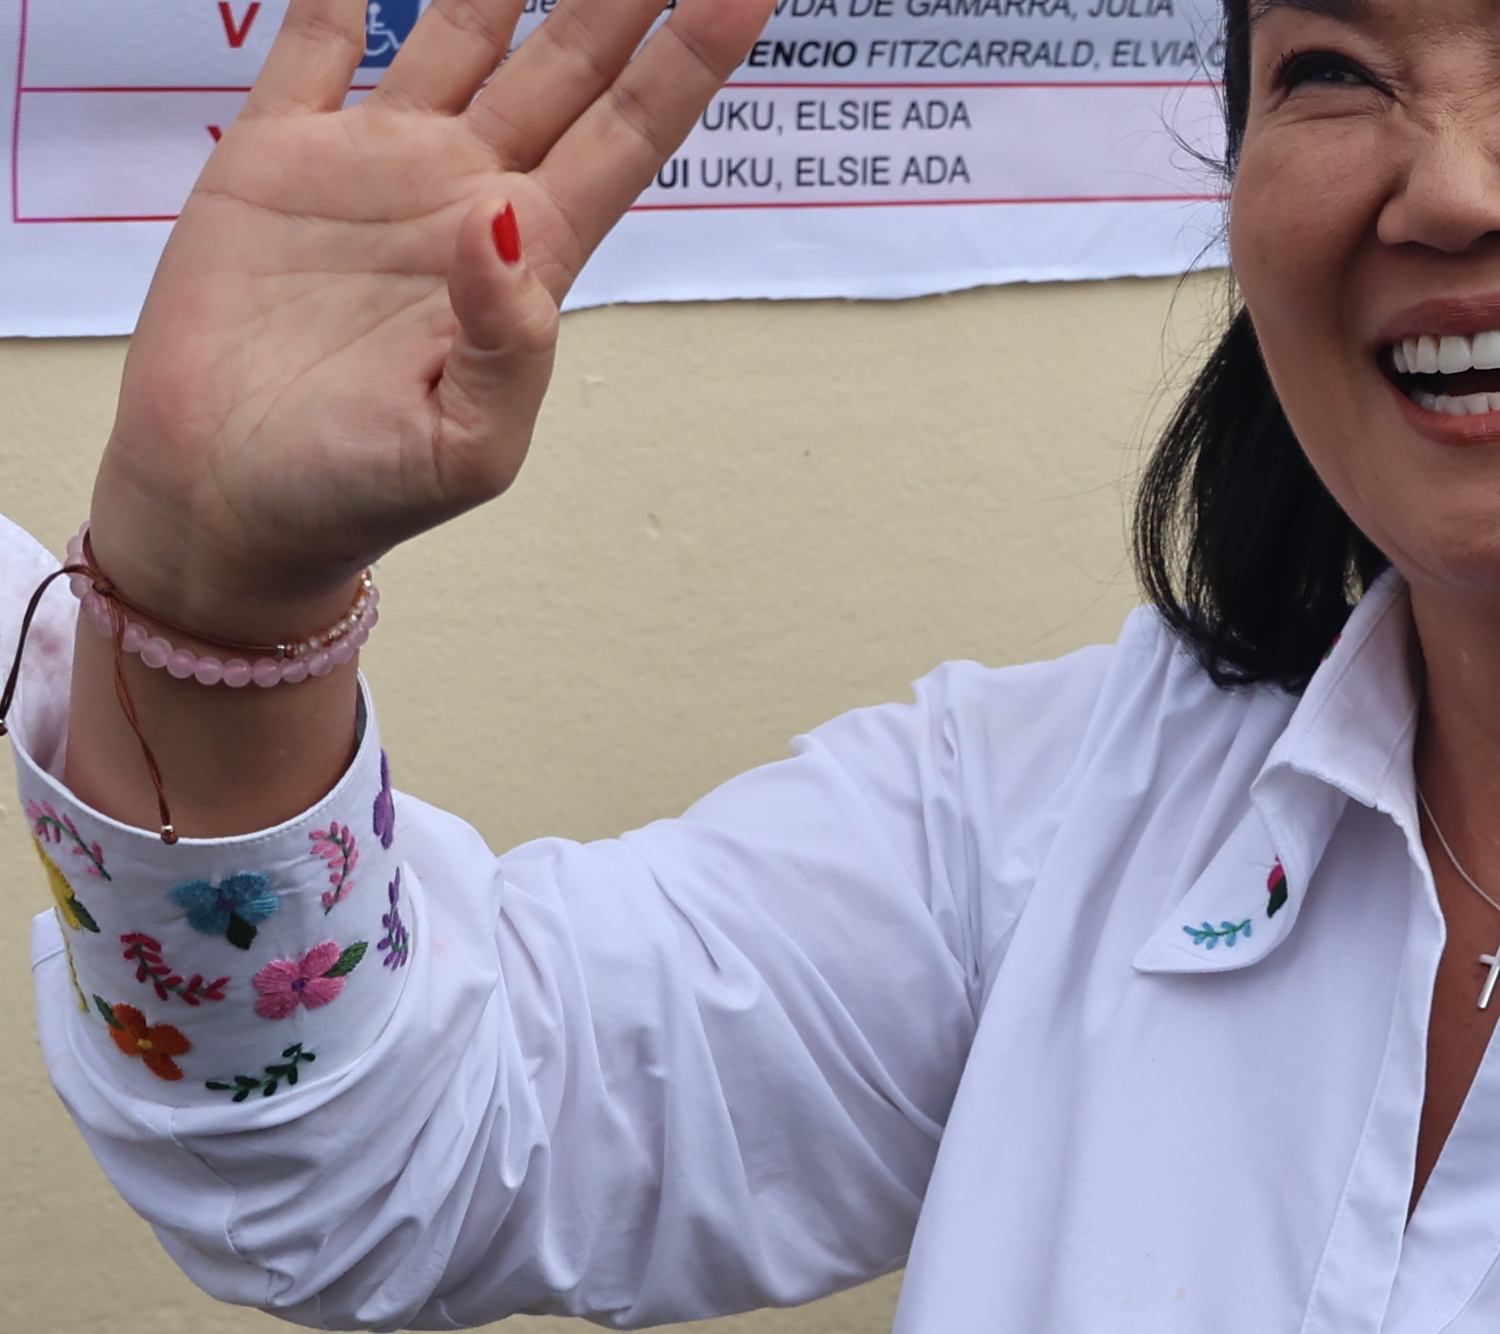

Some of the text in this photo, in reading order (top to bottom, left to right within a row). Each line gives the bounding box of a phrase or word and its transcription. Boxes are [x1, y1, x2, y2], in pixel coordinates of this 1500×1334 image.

[220, 2, 259, 47] V
[867, 39, 1099, 70] FITZCARRALD,
[1110, 39, 1200, 68] ELVIA
[701, 100, 971, 135] UKU, ELSIE ADA
[701, 157, 782, 191] UKU,
[795, 155, 891, 187] ELSIE
[901, 155, 970, 185] ADA
